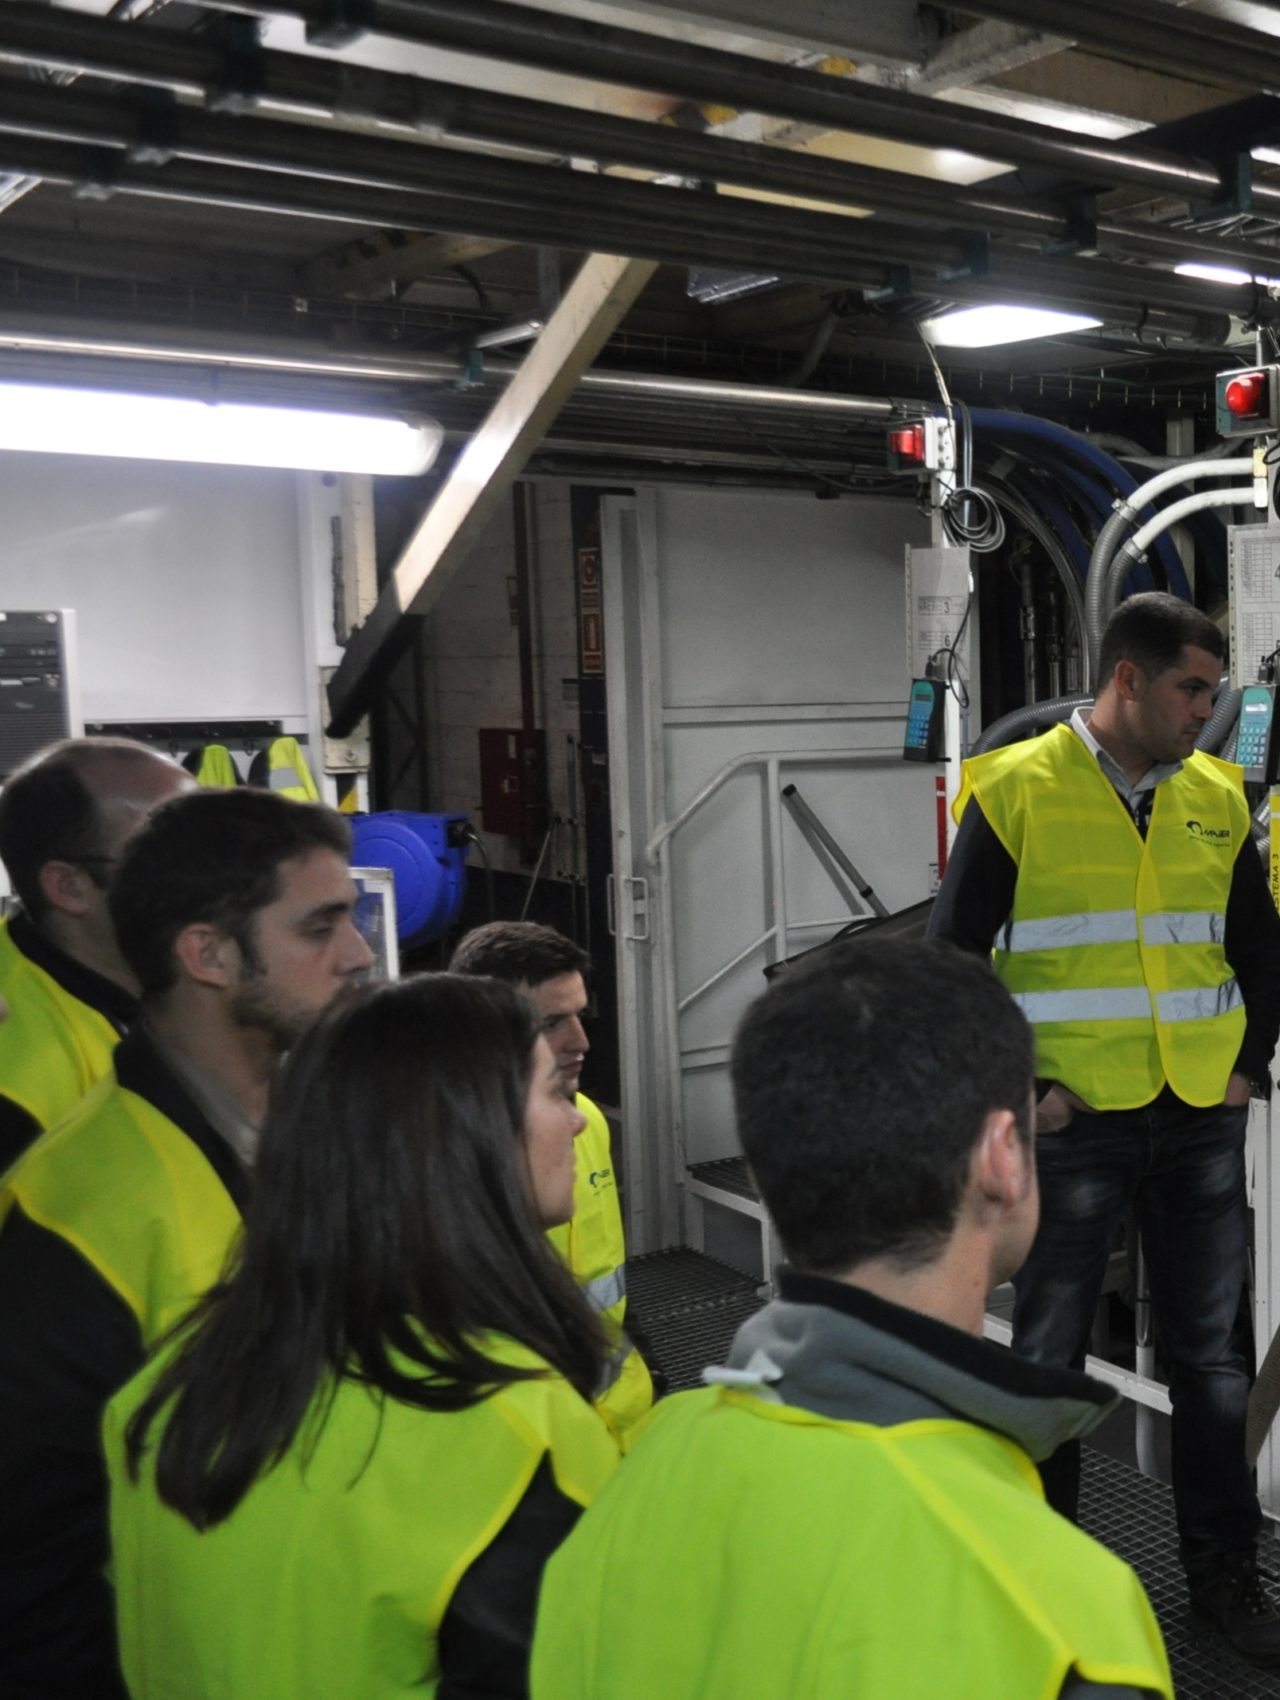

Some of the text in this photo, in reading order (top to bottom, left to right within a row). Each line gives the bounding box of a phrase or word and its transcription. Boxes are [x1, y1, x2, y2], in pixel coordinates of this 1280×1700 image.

[944, 634, 951, 647] 6
[1272, 853, 1280, 911] STEMA 3
